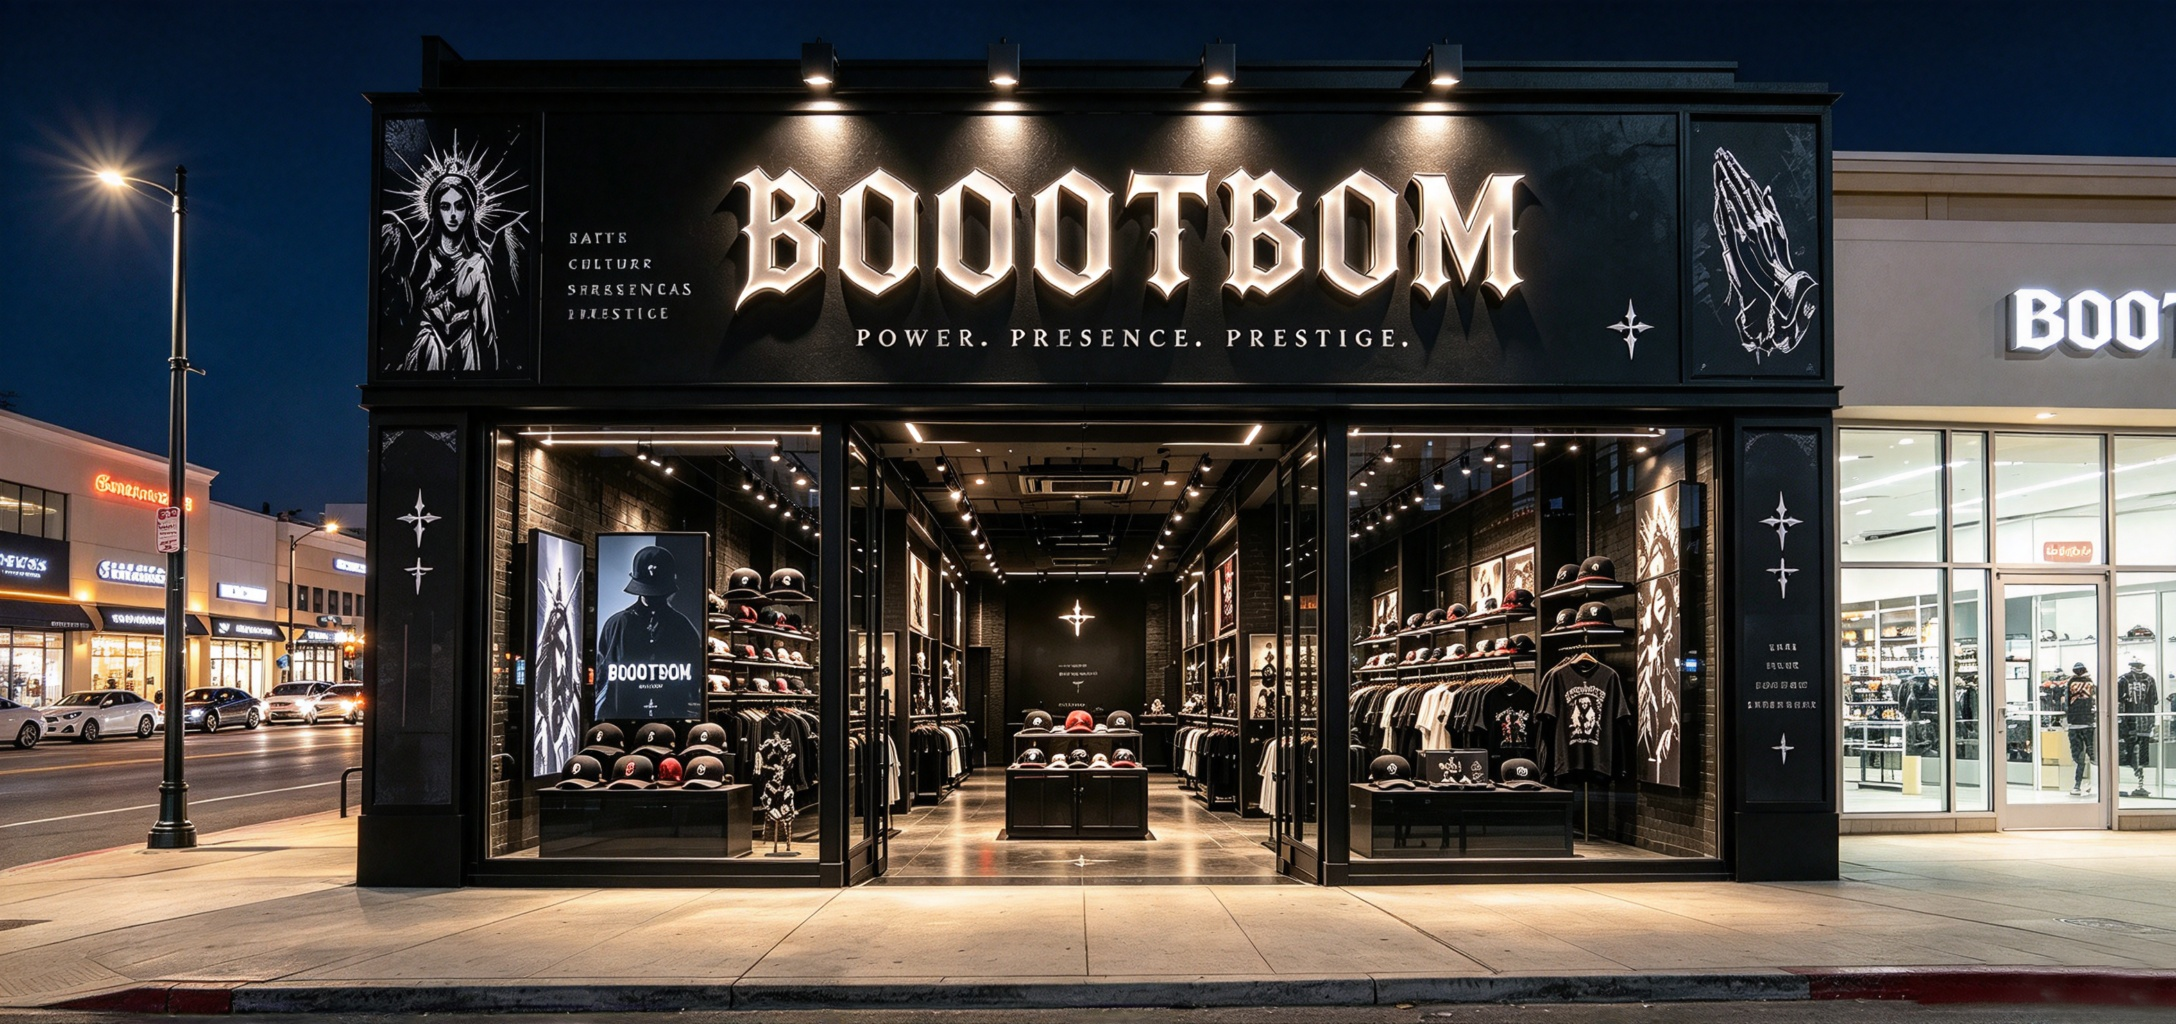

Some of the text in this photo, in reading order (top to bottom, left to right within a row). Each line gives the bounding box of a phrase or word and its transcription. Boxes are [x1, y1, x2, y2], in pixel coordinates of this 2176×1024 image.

[732, 165, 1527, 313] BOOOTBOM
[855, 328, 1409, 348] POWER. PRESENCE. PRESTIGE.
